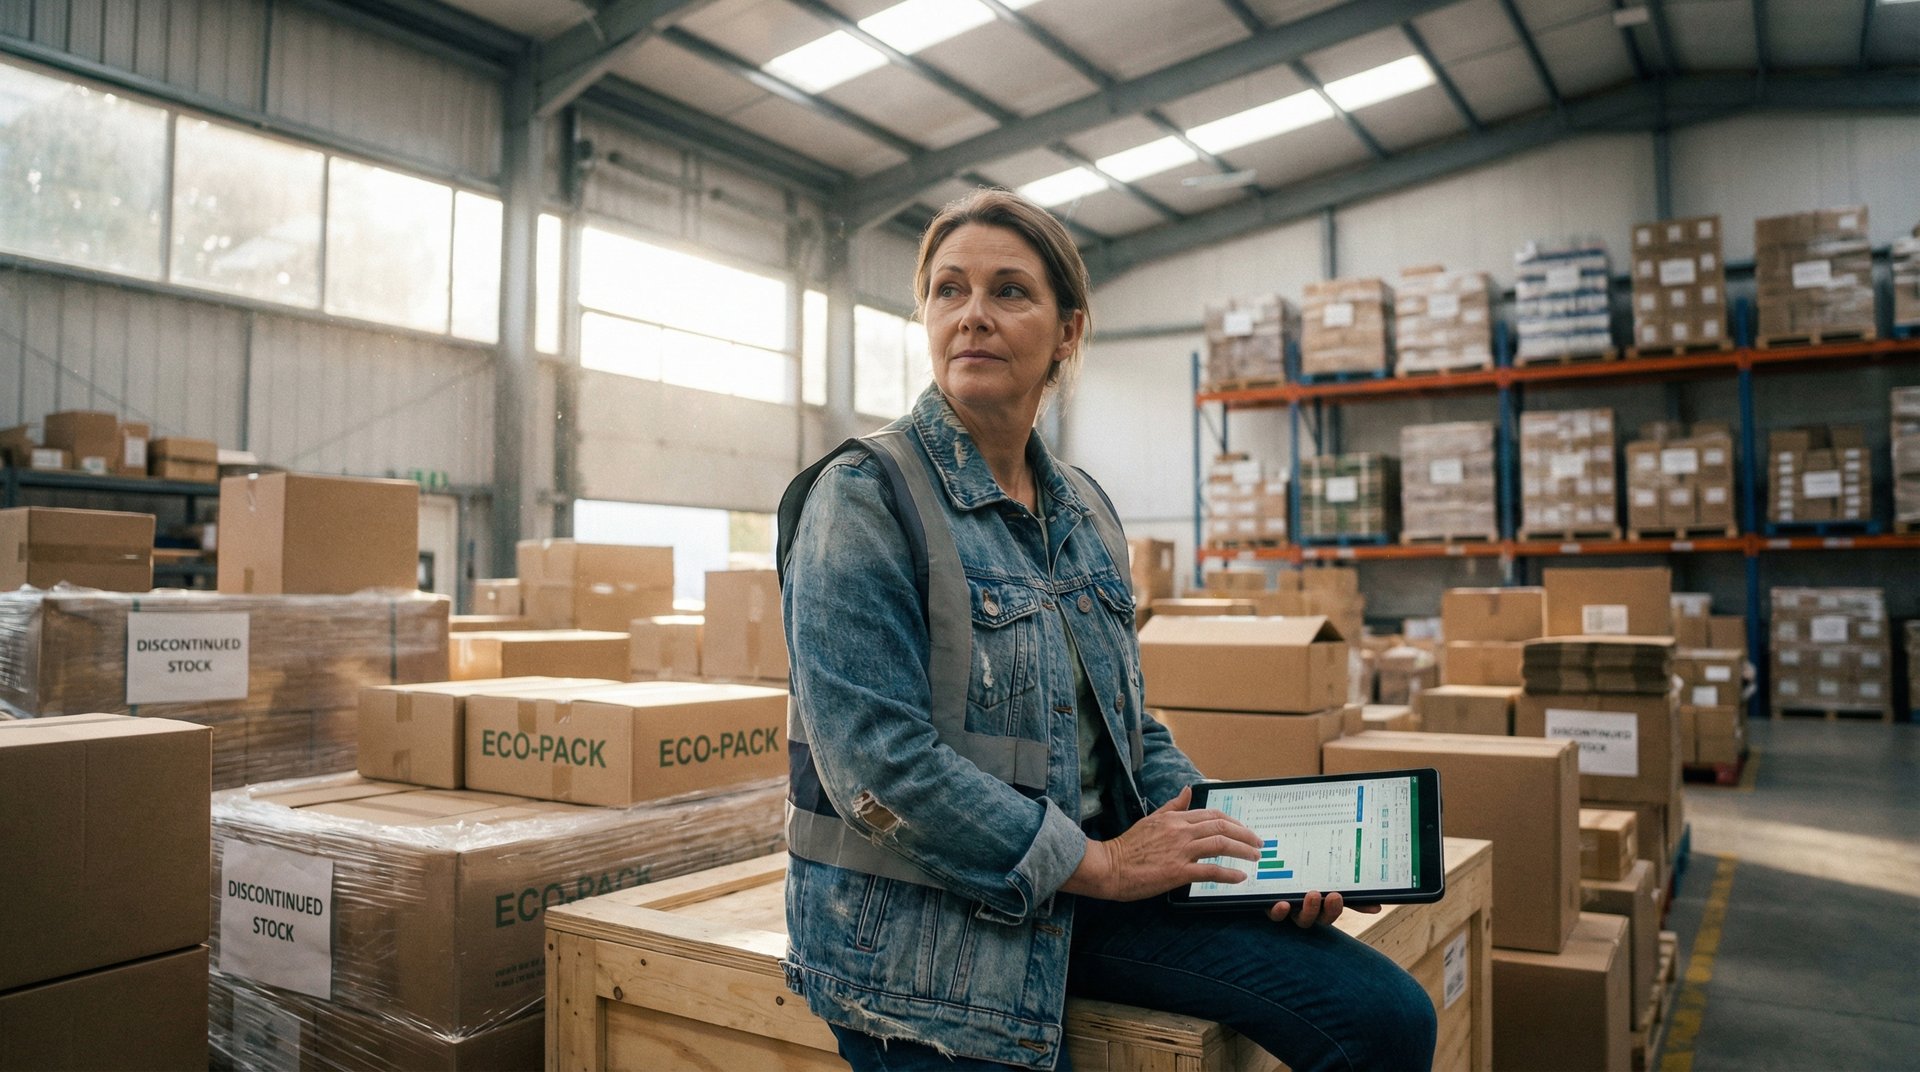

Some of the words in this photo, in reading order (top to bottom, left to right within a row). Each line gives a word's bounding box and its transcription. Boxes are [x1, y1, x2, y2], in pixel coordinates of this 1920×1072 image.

[136, 638, 241, 652] DISCONTINUED
[168, 659, 212, 673] STOCK
[482, 729, 606, 768] ECO-PACK
[659, 726, 779, 768] ECO-PACK
[1579, 741, 1607, 754] TOCK
[228, 880, 323, 916] DISCONTINUED
[252, 916, 295, 942] STOCK
